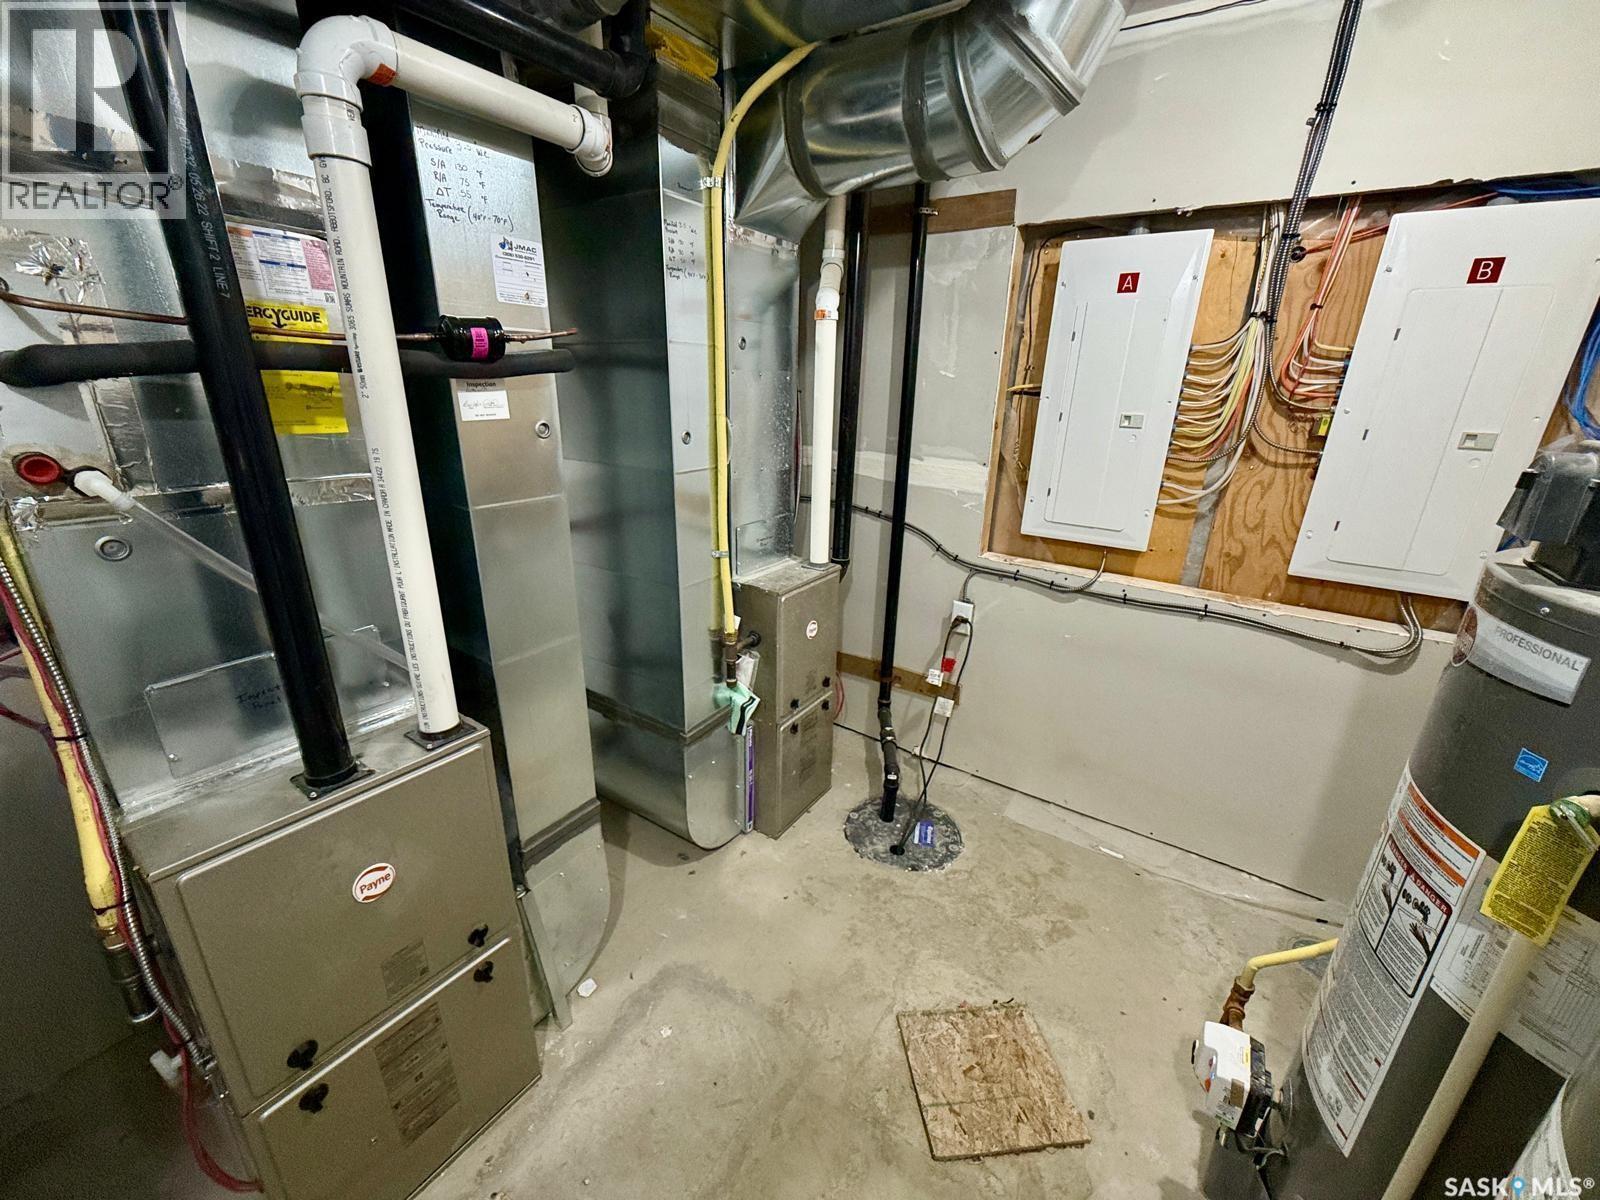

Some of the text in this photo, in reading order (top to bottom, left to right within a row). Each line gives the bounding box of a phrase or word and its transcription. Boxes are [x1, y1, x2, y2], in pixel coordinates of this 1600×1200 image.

[430, 158, 446, 169] S/A
[321, 174, 329, 183] BC
[433, 171, 447, 183] R/A
[460, 178, 470, 187] 75
[200, 221, 219, 252] SHIFT
[212, 266, 227, 289] LINE
[514, 244, 537, 254] JMAC
[338, 258, 348, 290] MOUNTAIN
[1476, 260, 1494, 280] B
[1121, 275, 1133, 291] A
[343, 293, 353, 312] SUMAS
[466, 381, 497, 389] Inspection
[385, 520, 393, 533] MADE
[1495, 625, 1580, 672] PROFESSIONAL
[360, 873, 391, 895] Payne
[1416, 880, 1448, 914] DANGER
